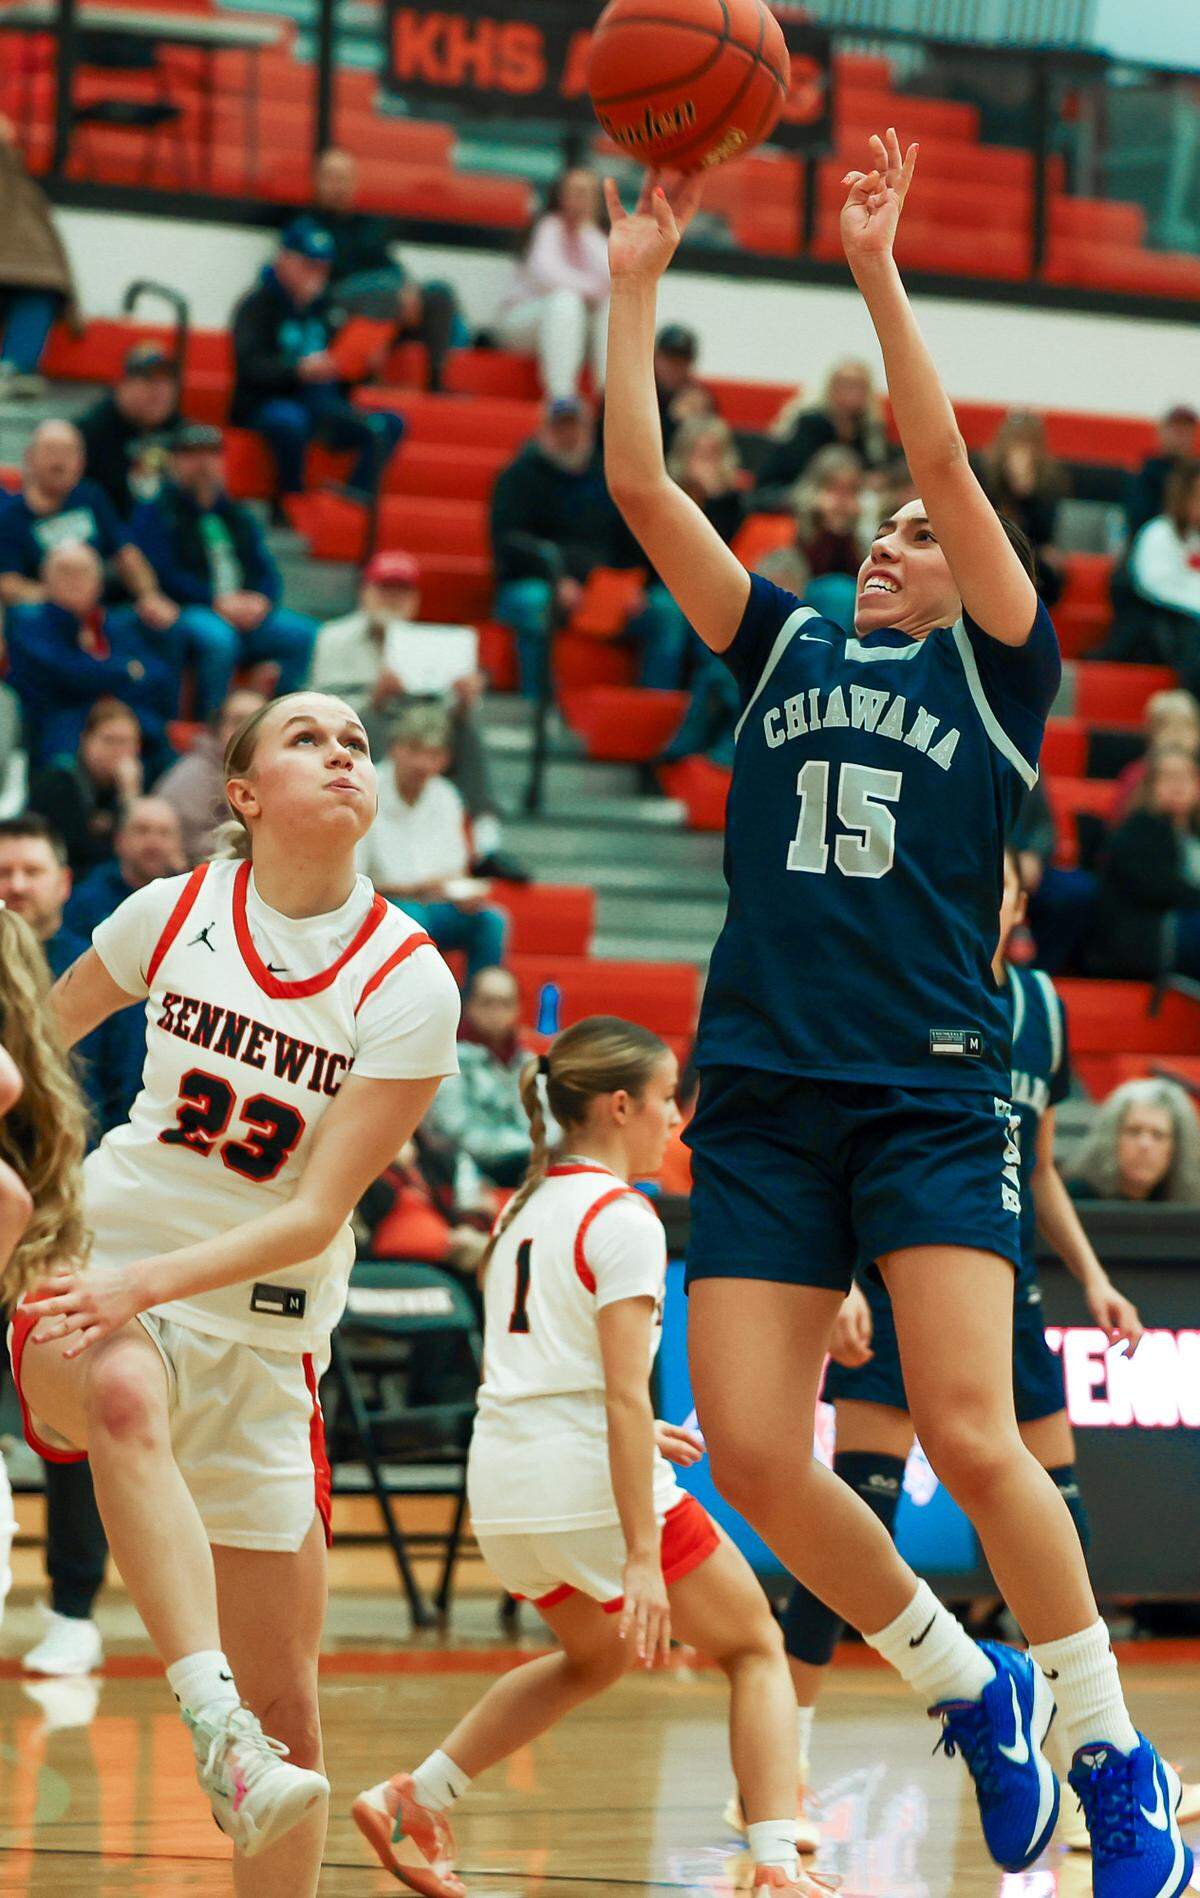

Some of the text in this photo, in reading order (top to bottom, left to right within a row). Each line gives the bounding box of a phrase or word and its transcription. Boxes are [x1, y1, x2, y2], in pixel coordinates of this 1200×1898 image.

[392, 9, 547, 95] KHS
[763, 684, 960, 771] CHIAWANA
[786, 760, 902, 879] 15
[157, 991, 355, 1097] KENNEWIC
[970, 1037, 979, 1050] M
[157, 1067, 306, 1182] 23
[508, 1238, 533, 1334] 1
